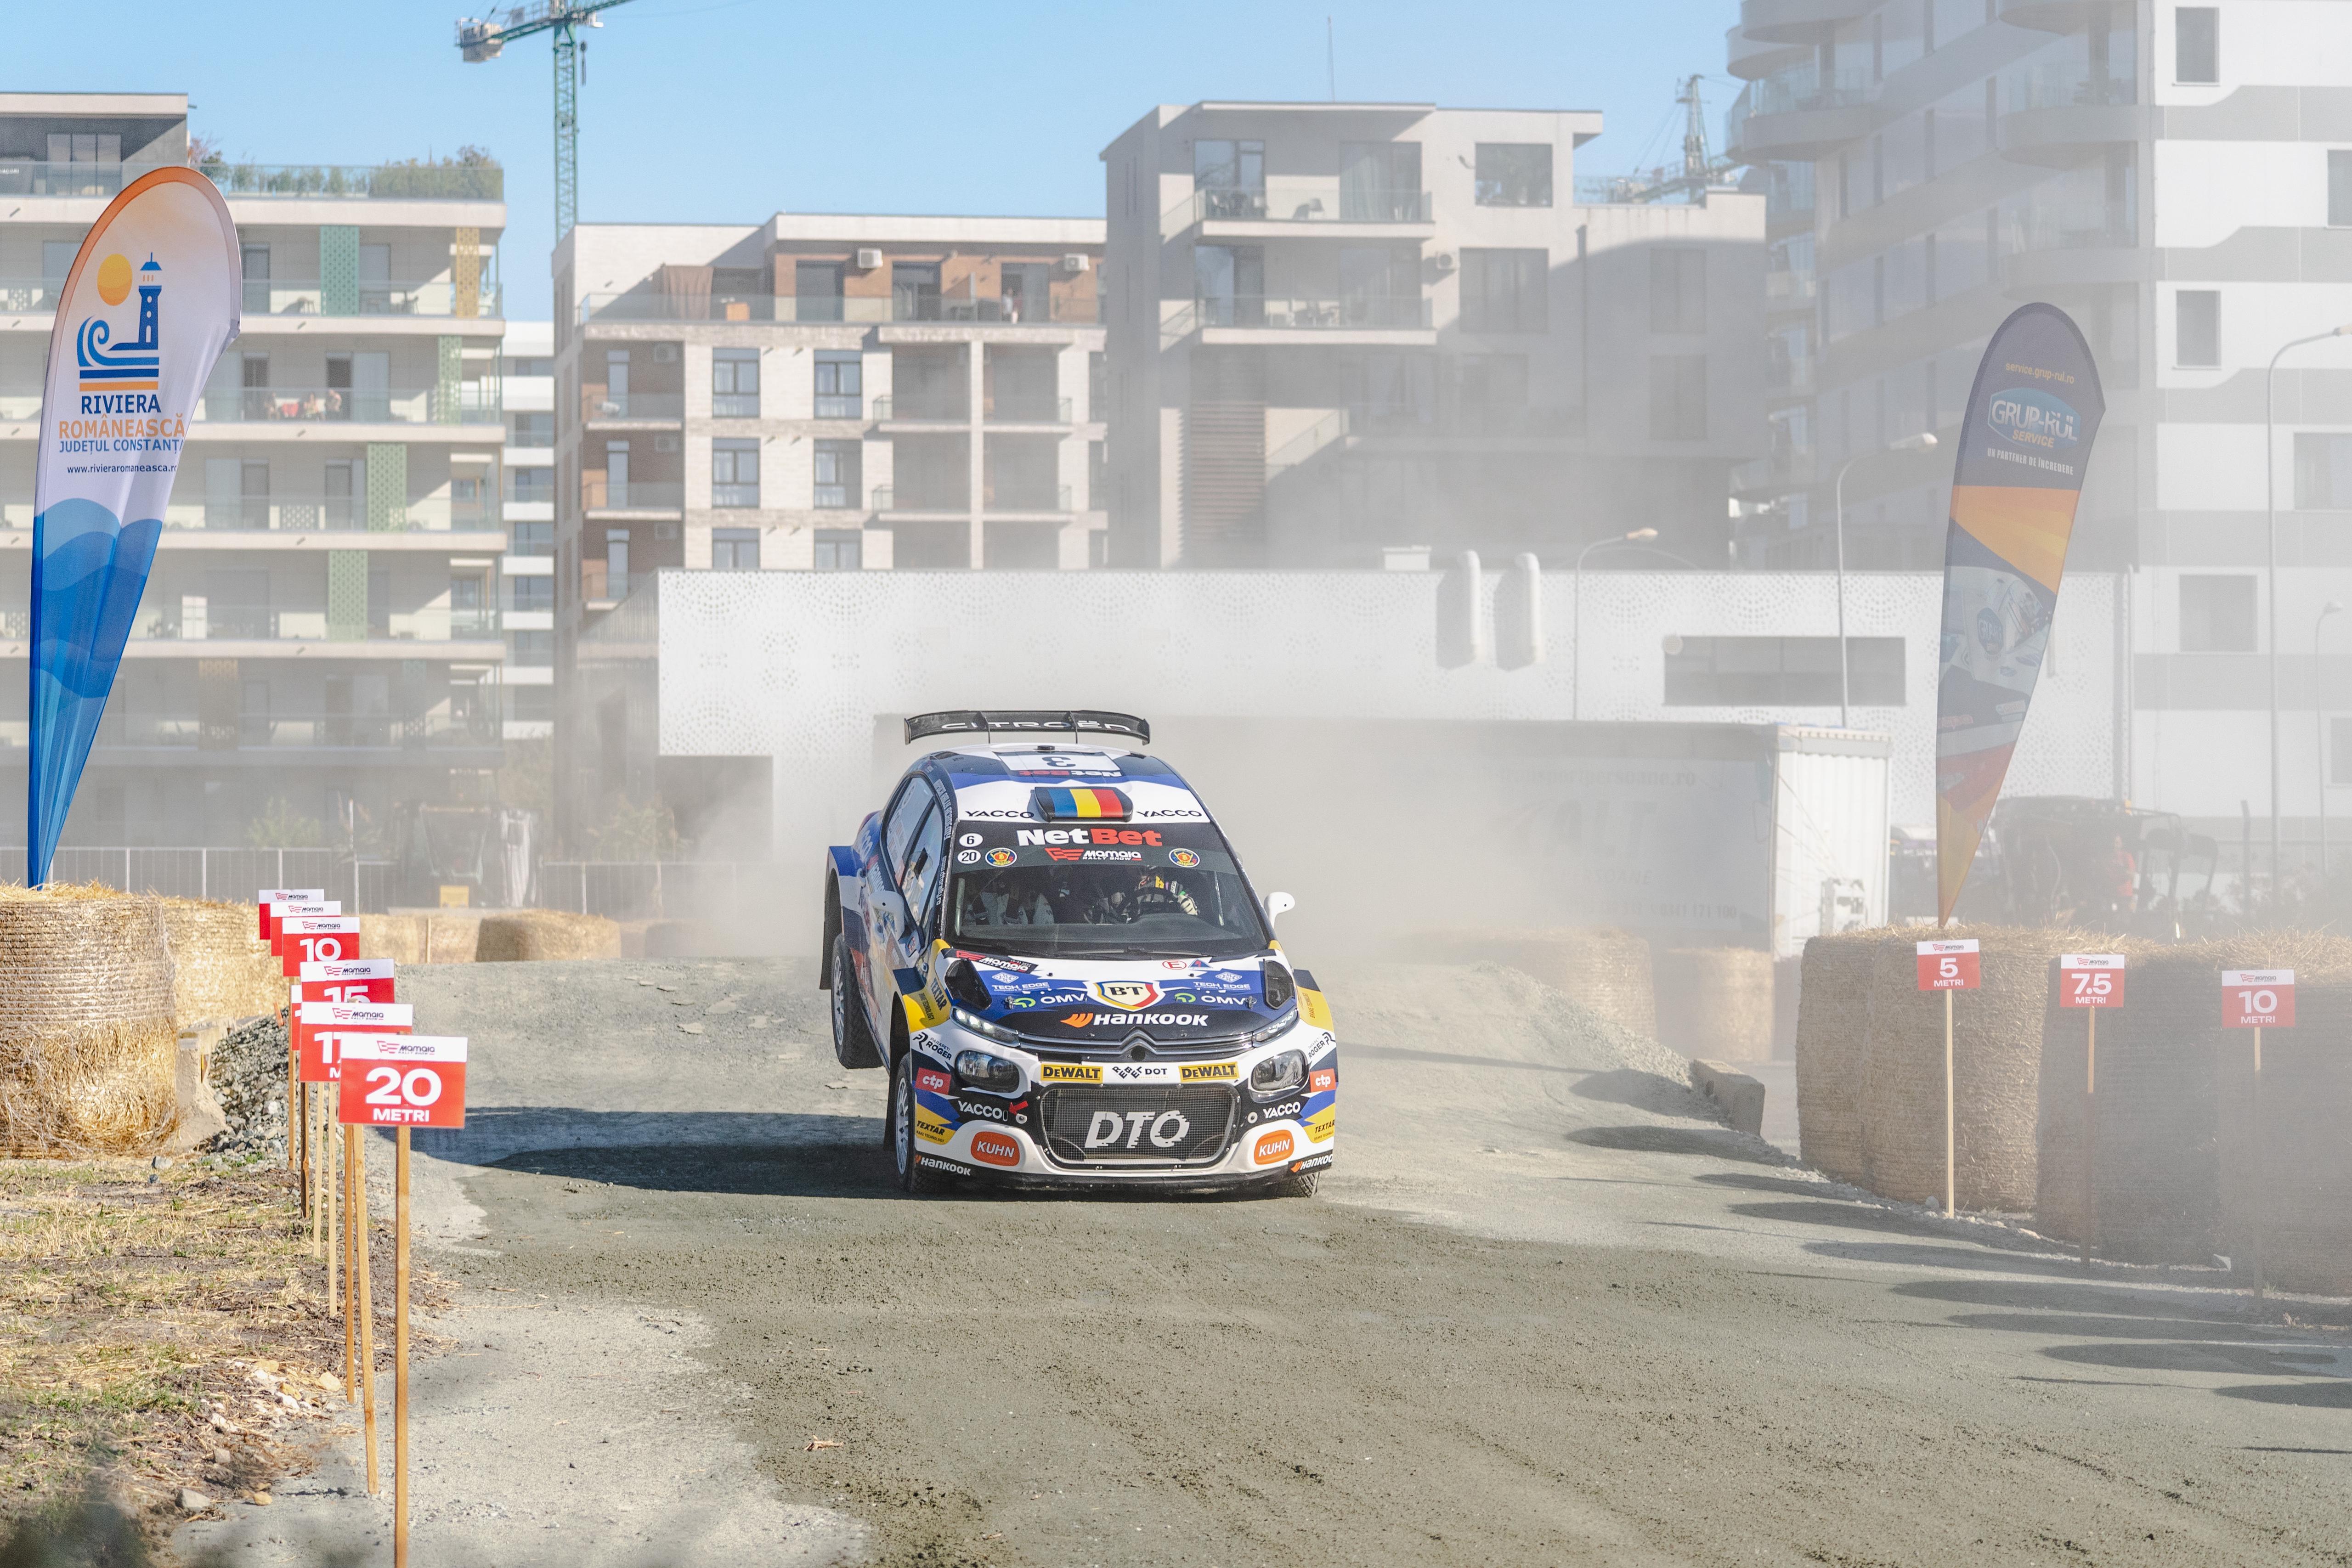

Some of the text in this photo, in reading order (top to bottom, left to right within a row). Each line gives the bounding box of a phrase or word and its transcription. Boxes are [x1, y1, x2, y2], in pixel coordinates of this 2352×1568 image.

[81, 394, 162, 414] RIVIERA
[59, 413, 185, 439] ROMÂNEASCĂ
[2012, 429, 2055, 448] SERVICE
[1987, 447, 1996, 457] UN
[2029, 457, 2037, 467] DE
[1042, 756, 1076, 767] 3
[965, 810, 1035, 819] YACCO
[1136, 809, 1203, 818] YACCO
[966, 835, 974, 844] 6
[1016, 828, 1163, 846] NetBet
[961, 852, 979, 862] 20
[300, 937, 342, 962] 10
[1939, 957, 1958, 978] 5
[1108, 987, 1143, 996] BT
[1934, 979, 1964, 987] METRI
[2071, 973, 2112, 995] 7.5
[931, 978, 946, 1010] TEXTAR
[1040, 993, 1085, 1004] OMV
[1201, 994, 1246, 1005] OMV
[2238, 990, 2278, 1014] 10
[2240, 1015, 2275, 1024] METRI
[926, 1041, 952, 1060] ROGER
[1308, 1040, 1325, 1059] ROGER
[366, 1066, 442, 1106] 20
[922, 1075, 944, 1089] ctp
[1315, 1074, 1331, 1088] ctp
[373, 1107, 430, 1122] METRI
[957, 1100, 1003, 1119] YACCO
[1262, 1101, 1301, 1119] YACCO
[917, 1120, 945, 1136] TEXTAR
[1085, 1110, 1190, 1149] DTO
[977, 1141, 1015, 1158] KUHN
[1259, 1139, 1290, 1157] KUHN
